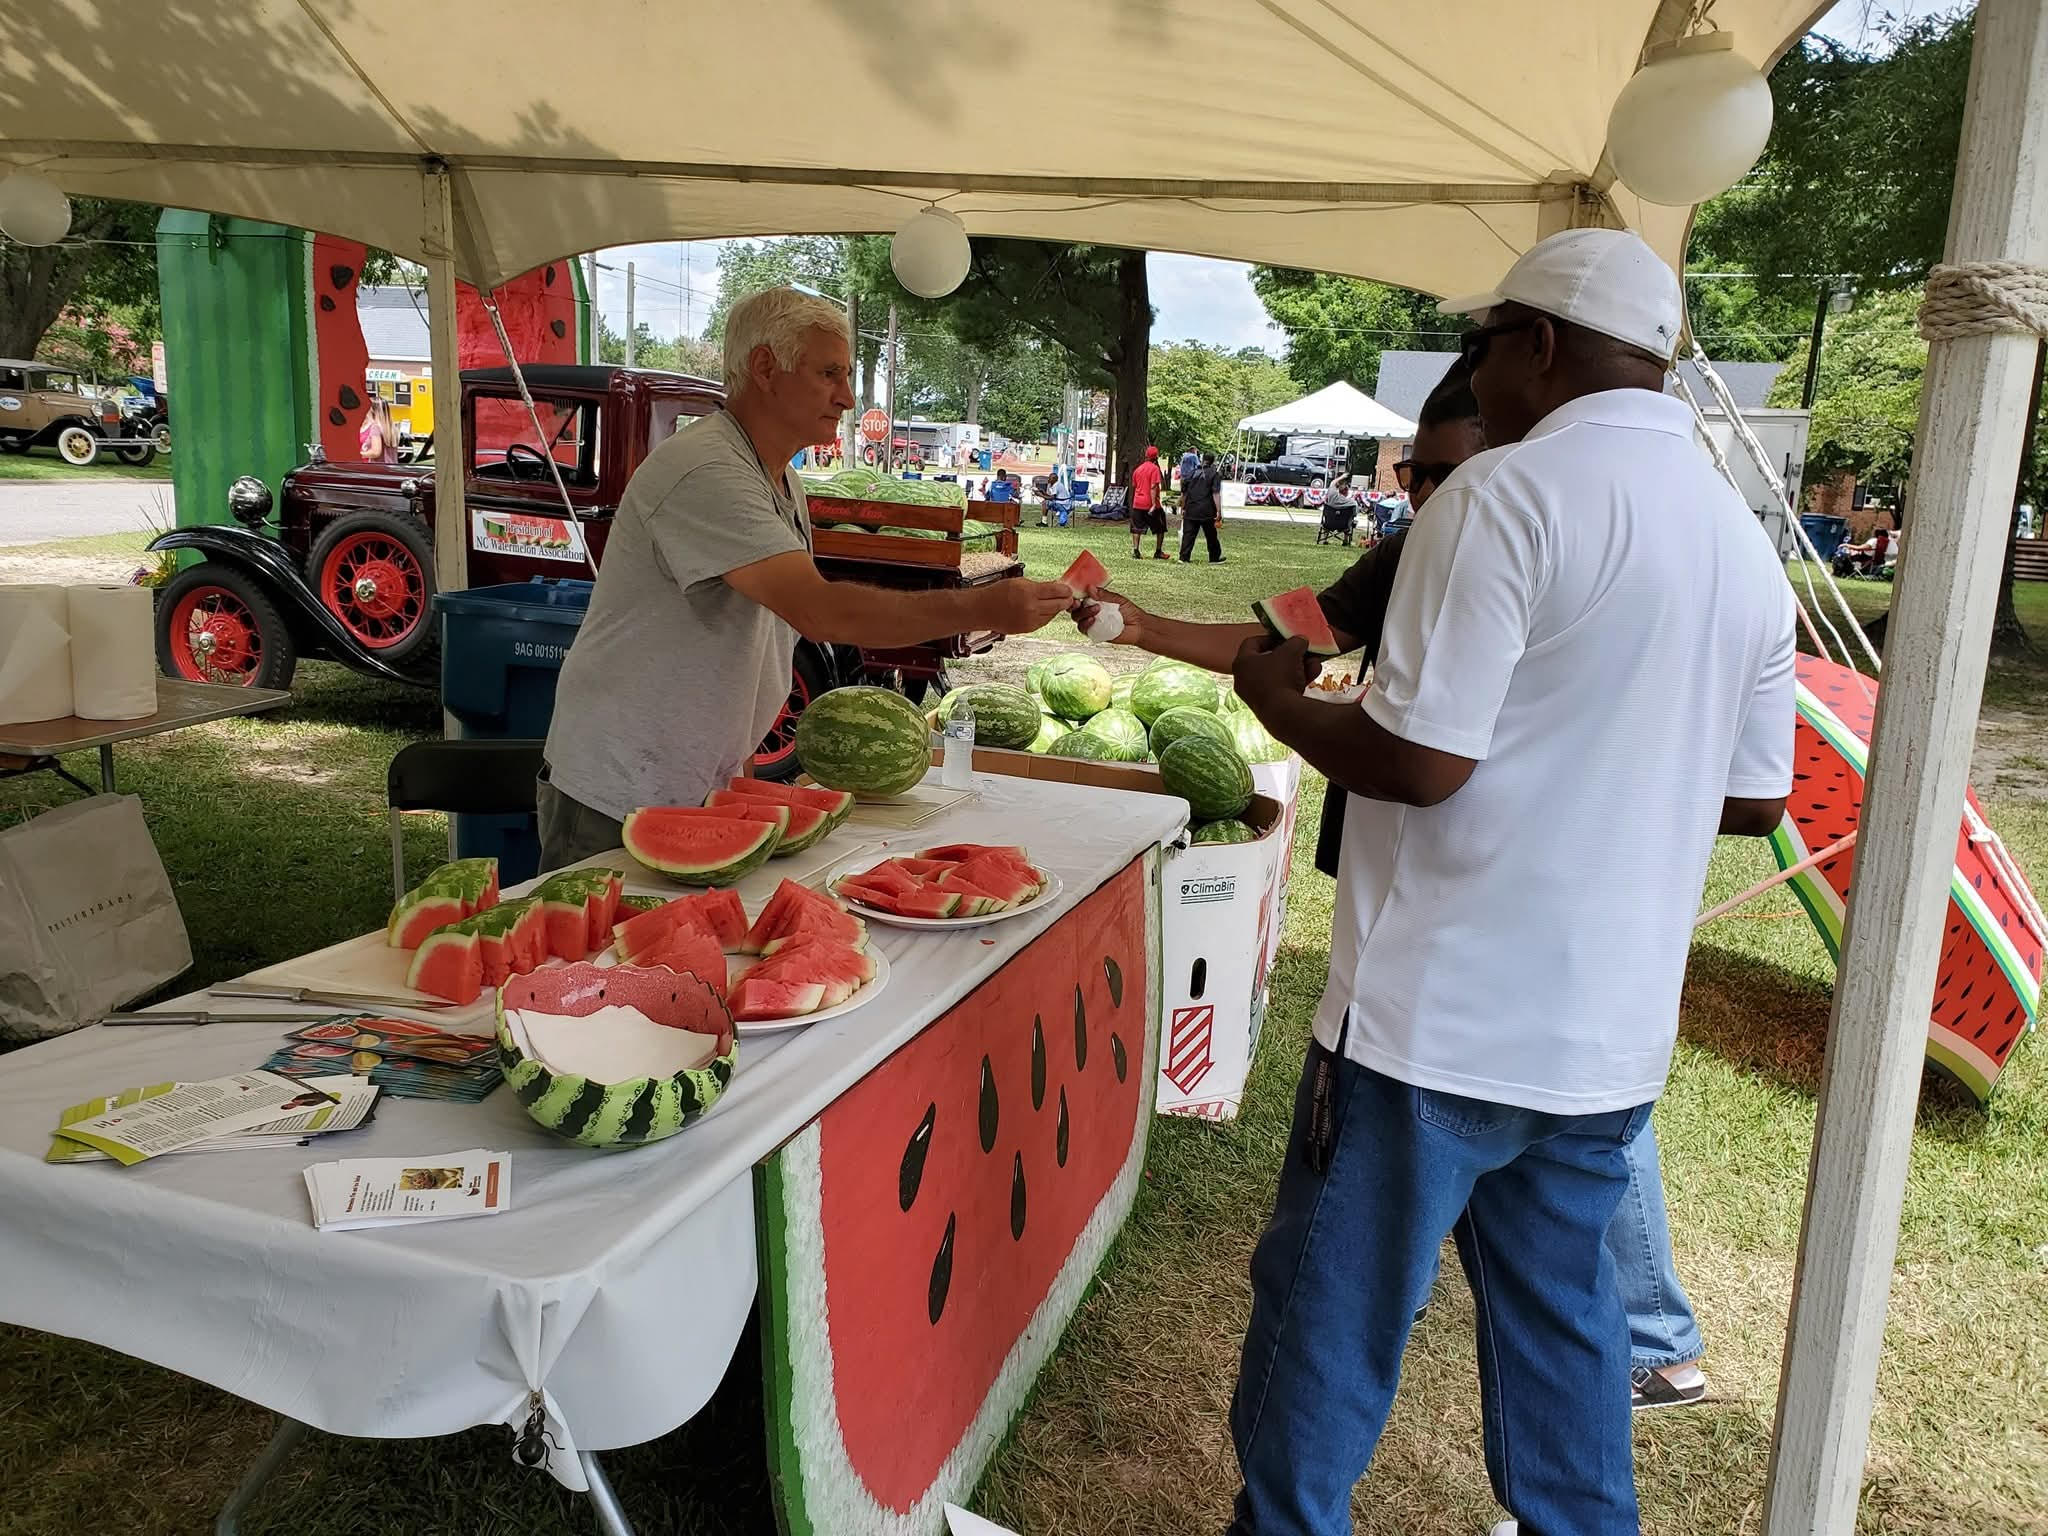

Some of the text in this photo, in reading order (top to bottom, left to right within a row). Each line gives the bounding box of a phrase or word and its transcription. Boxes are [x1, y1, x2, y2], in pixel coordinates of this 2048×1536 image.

[369, 371, 397, 379] CREAM
[863, 421, 888, 432] STOP
[965, 431, 971, 440] 5
[505, 521, 553, 538] President of
[476, 536, 585, 561] NC Watermelon Association
[514, 641, 533, 657] 9AG
[1191, 880, 1235, 894] ClimaBin
